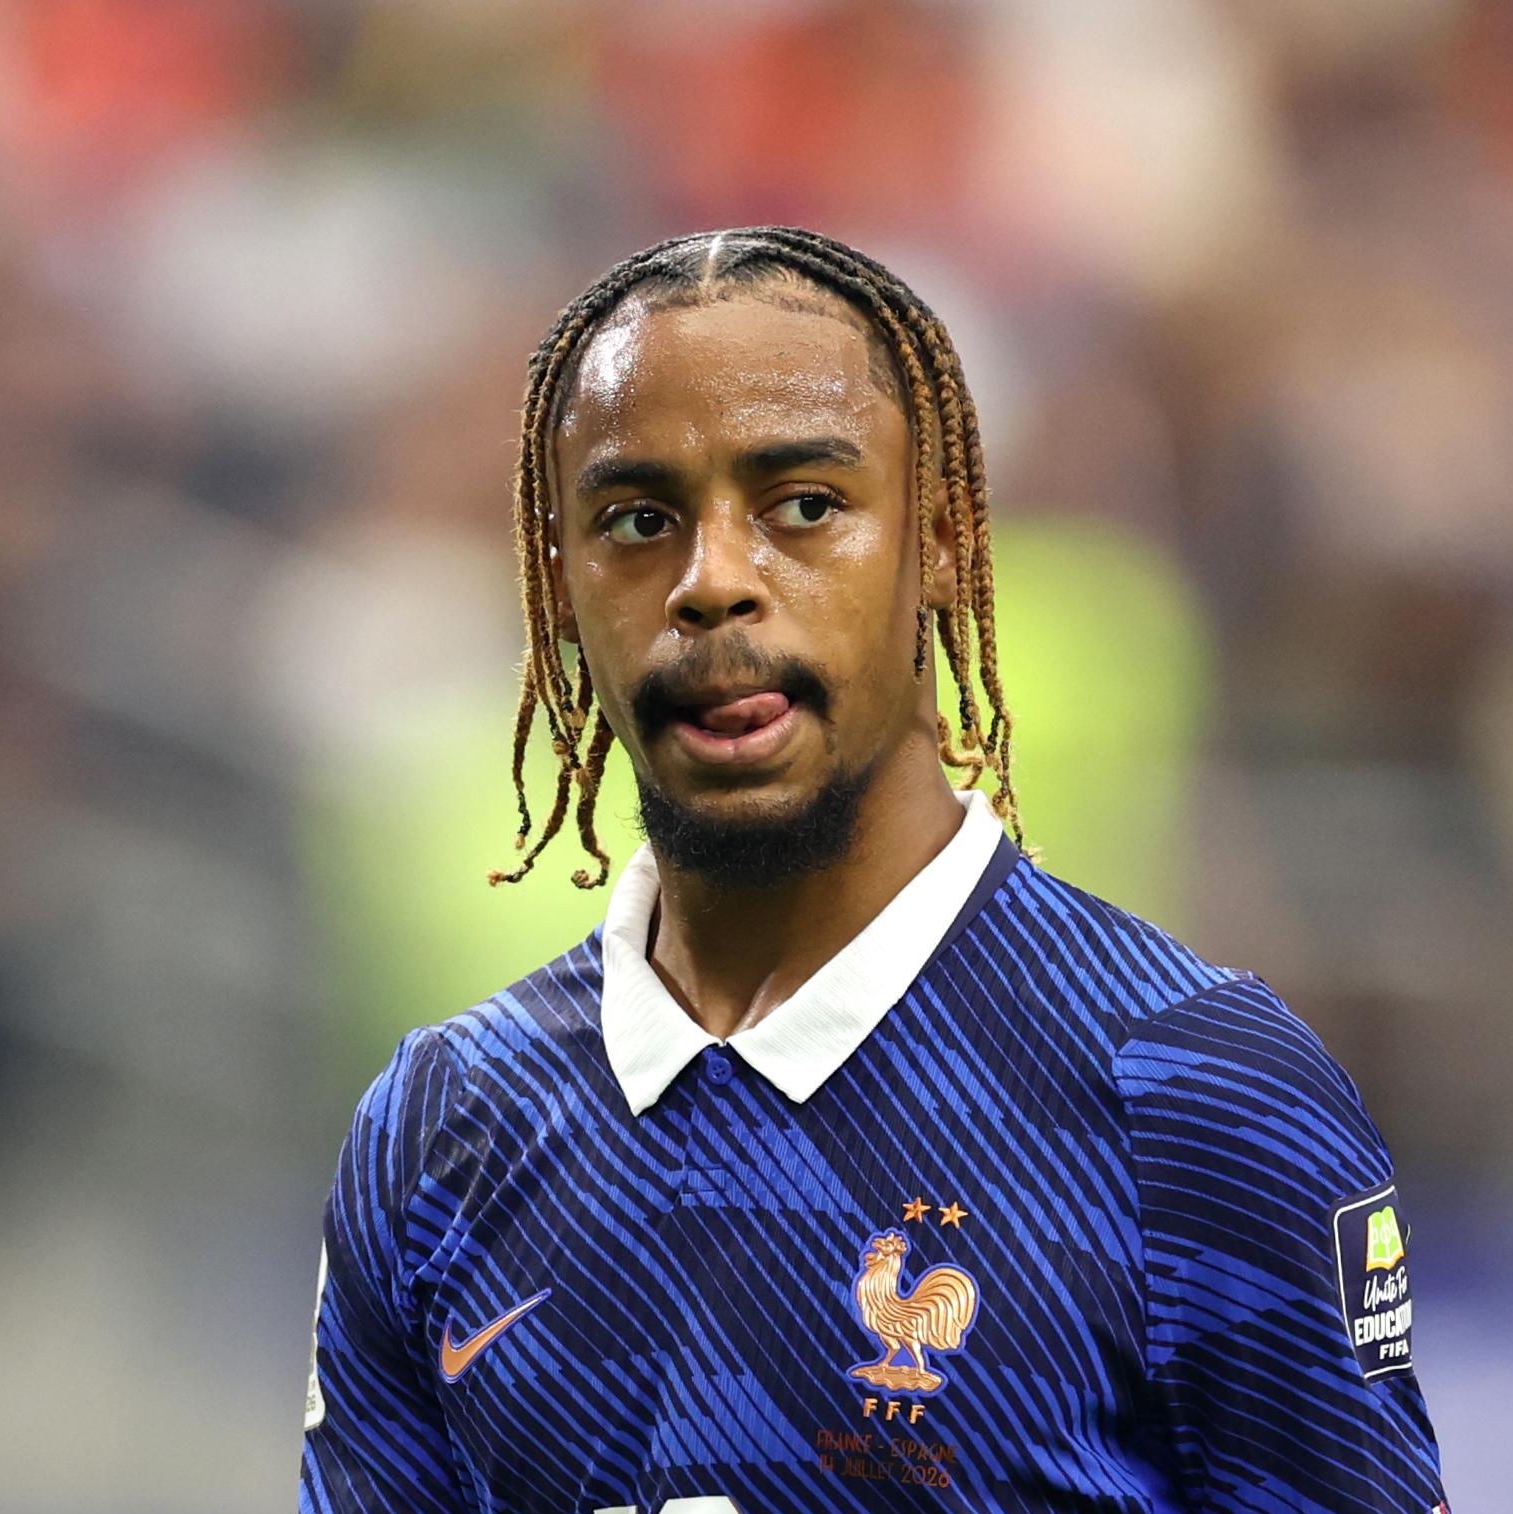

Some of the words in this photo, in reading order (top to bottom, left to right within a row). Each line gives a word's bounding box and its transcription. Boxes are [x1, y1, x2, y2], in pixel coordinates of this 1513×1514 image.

[1364, 1273, 1397, 1312] Unite
[1379, 1338, 1410, 1360] FIFA
[816, 1429, 873, 1454] FRANCE
[890, 1438, 958, 1464] ESPAGNE
[819, 1453, 834, 1474] 14
[841, 1456, 895, 1480] JUILLET
[901, 1463, 950, 1488] 2026
